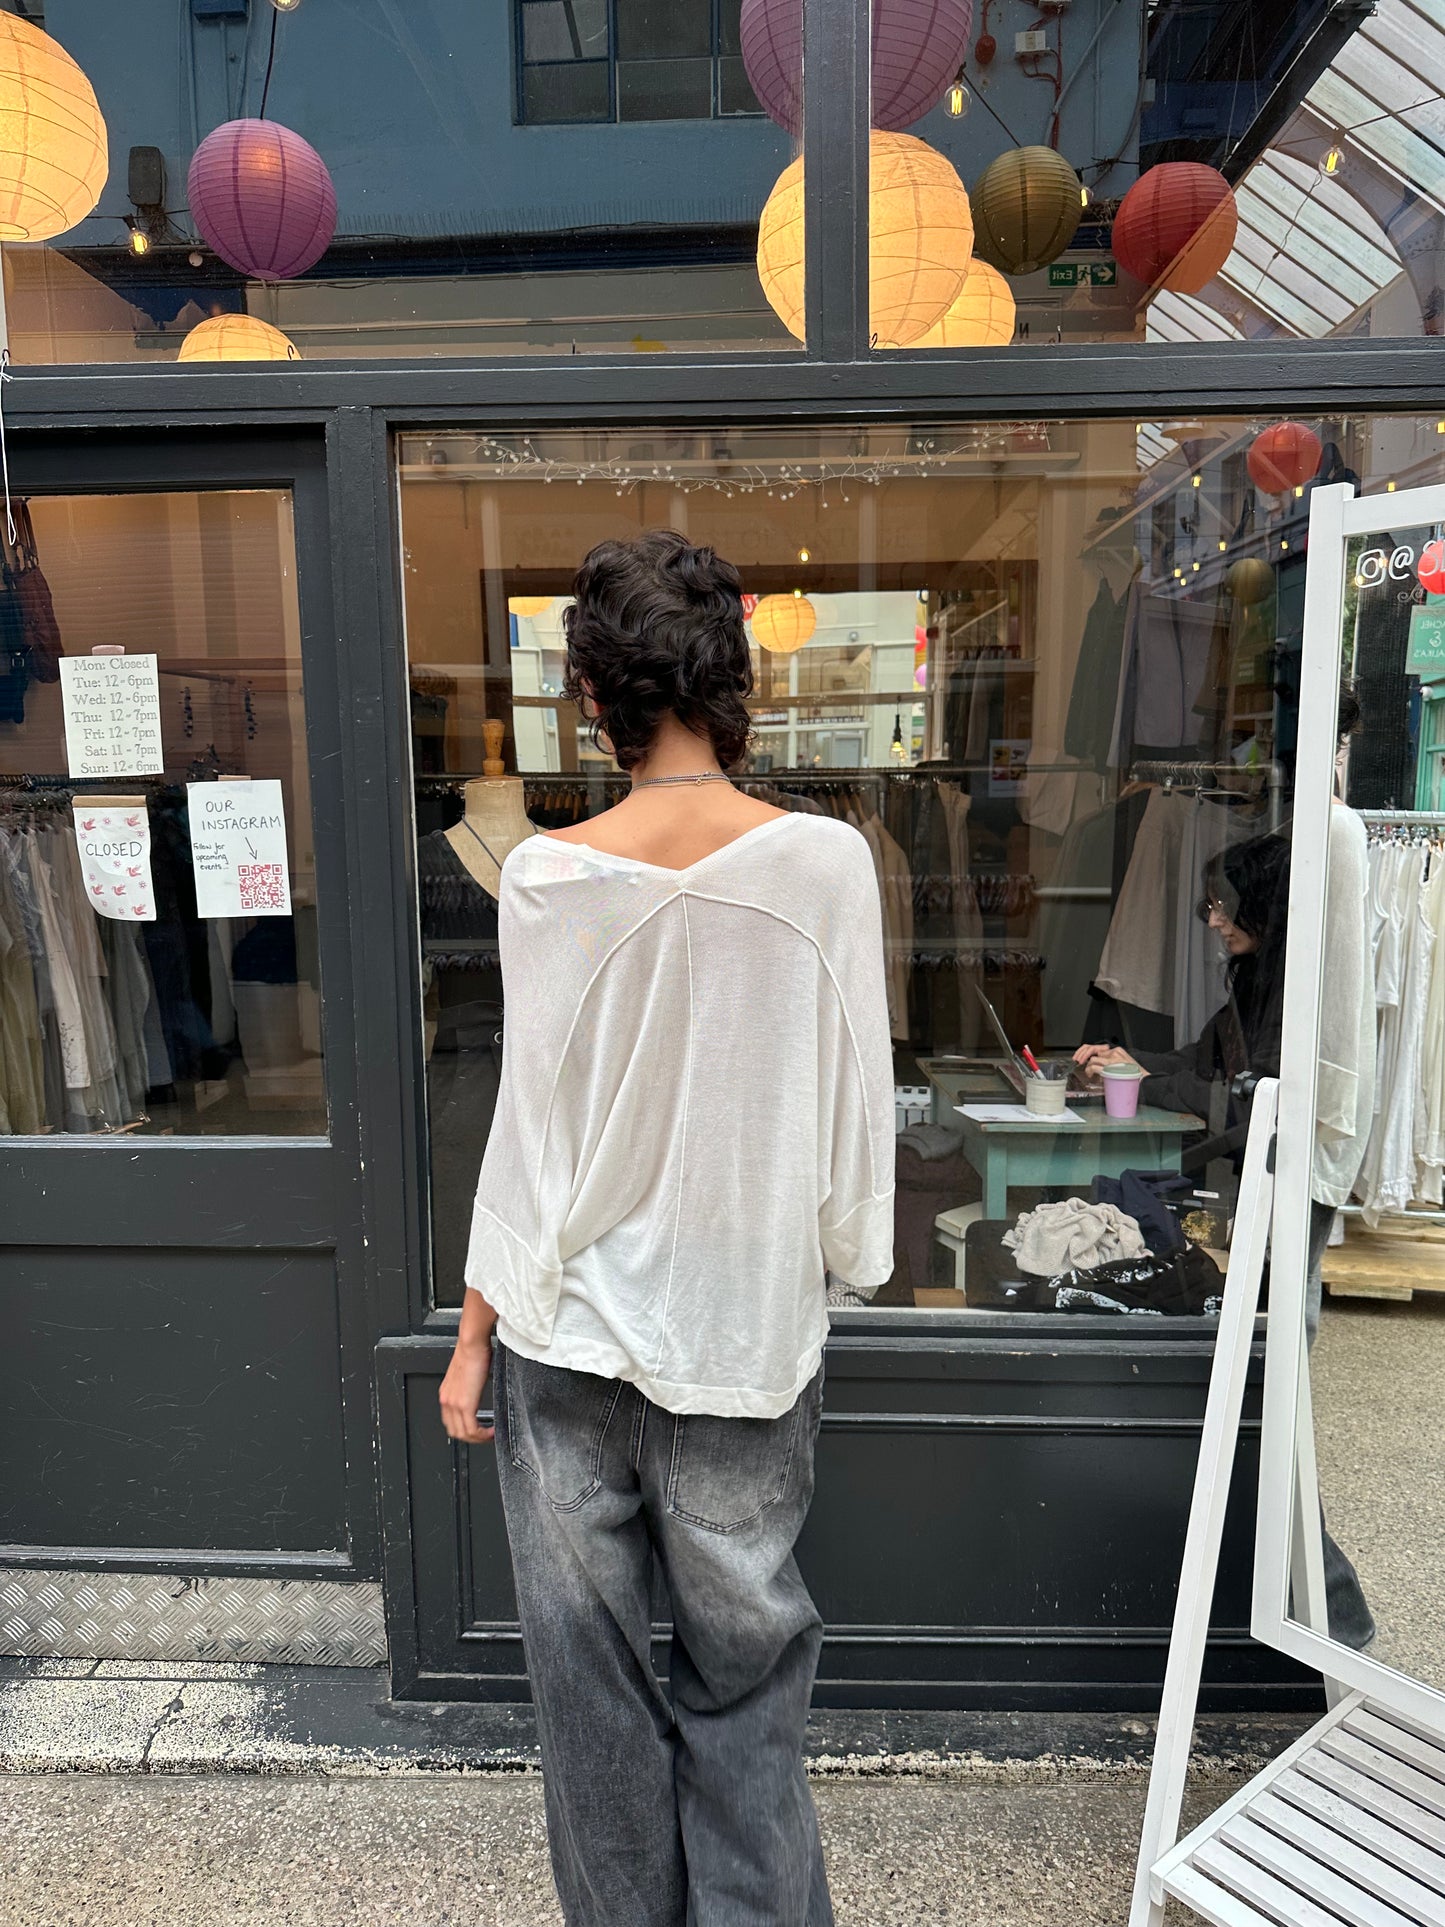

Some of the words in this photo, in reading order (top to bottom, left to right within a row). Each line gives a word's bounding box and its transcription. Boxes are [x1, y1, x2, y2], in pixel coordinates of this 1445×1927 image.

[73, 659, 106, 671] Mon:
[109, 657, 150, 670] Closed
[73, 676, 101, 688] Tue:
[72, 694, 106, 705] Wed:
[71, 711, 102, 723] Thu:
[83, 728, 105, 740] Fri:
[84, 745, 107, 756] Sat:
[80, 762, 109, 774] Sun:
[205, 799, 235, 813] OUR
[202, 815, 281, 831] INSTAGRAM
[85, 841, 143, 857] CLOSED
[193, 843, 212, 851] Follow
[195, 854, 229, 865] upcoming
